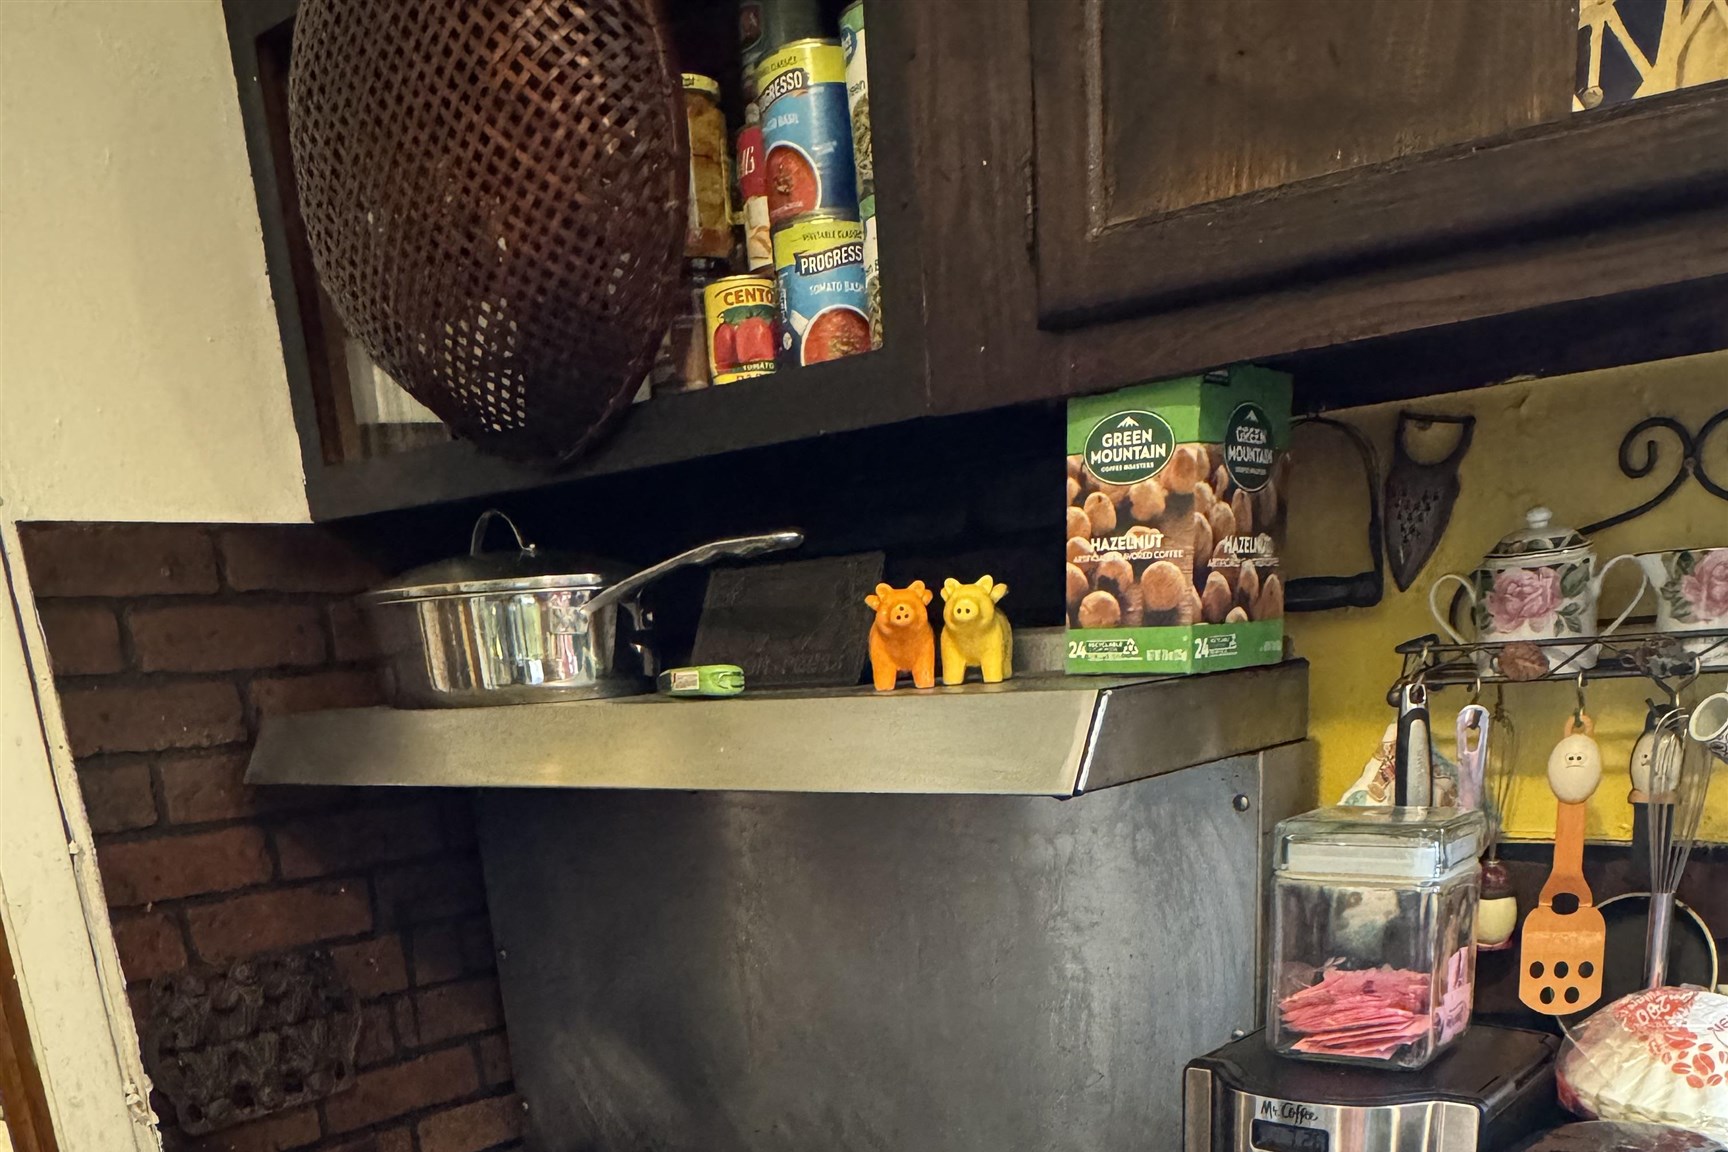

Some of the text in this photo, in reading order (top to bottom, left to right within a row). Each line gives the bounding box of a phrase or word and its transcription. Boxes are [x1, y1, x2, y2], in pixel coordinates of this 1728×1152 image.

[800, 245, 863, 274] PROGRESS
[1101, 428, 1153, 448] GREEN
[1090, 443, 1167, 465] MOUNTAIN
[1090, 533, 1165, 553] HAZELNUT
[1068, 640, 1087, 659] 24
[1194, 637, 1209, 659] 24
[1281, 1102, 1319, 1125] Coffee
